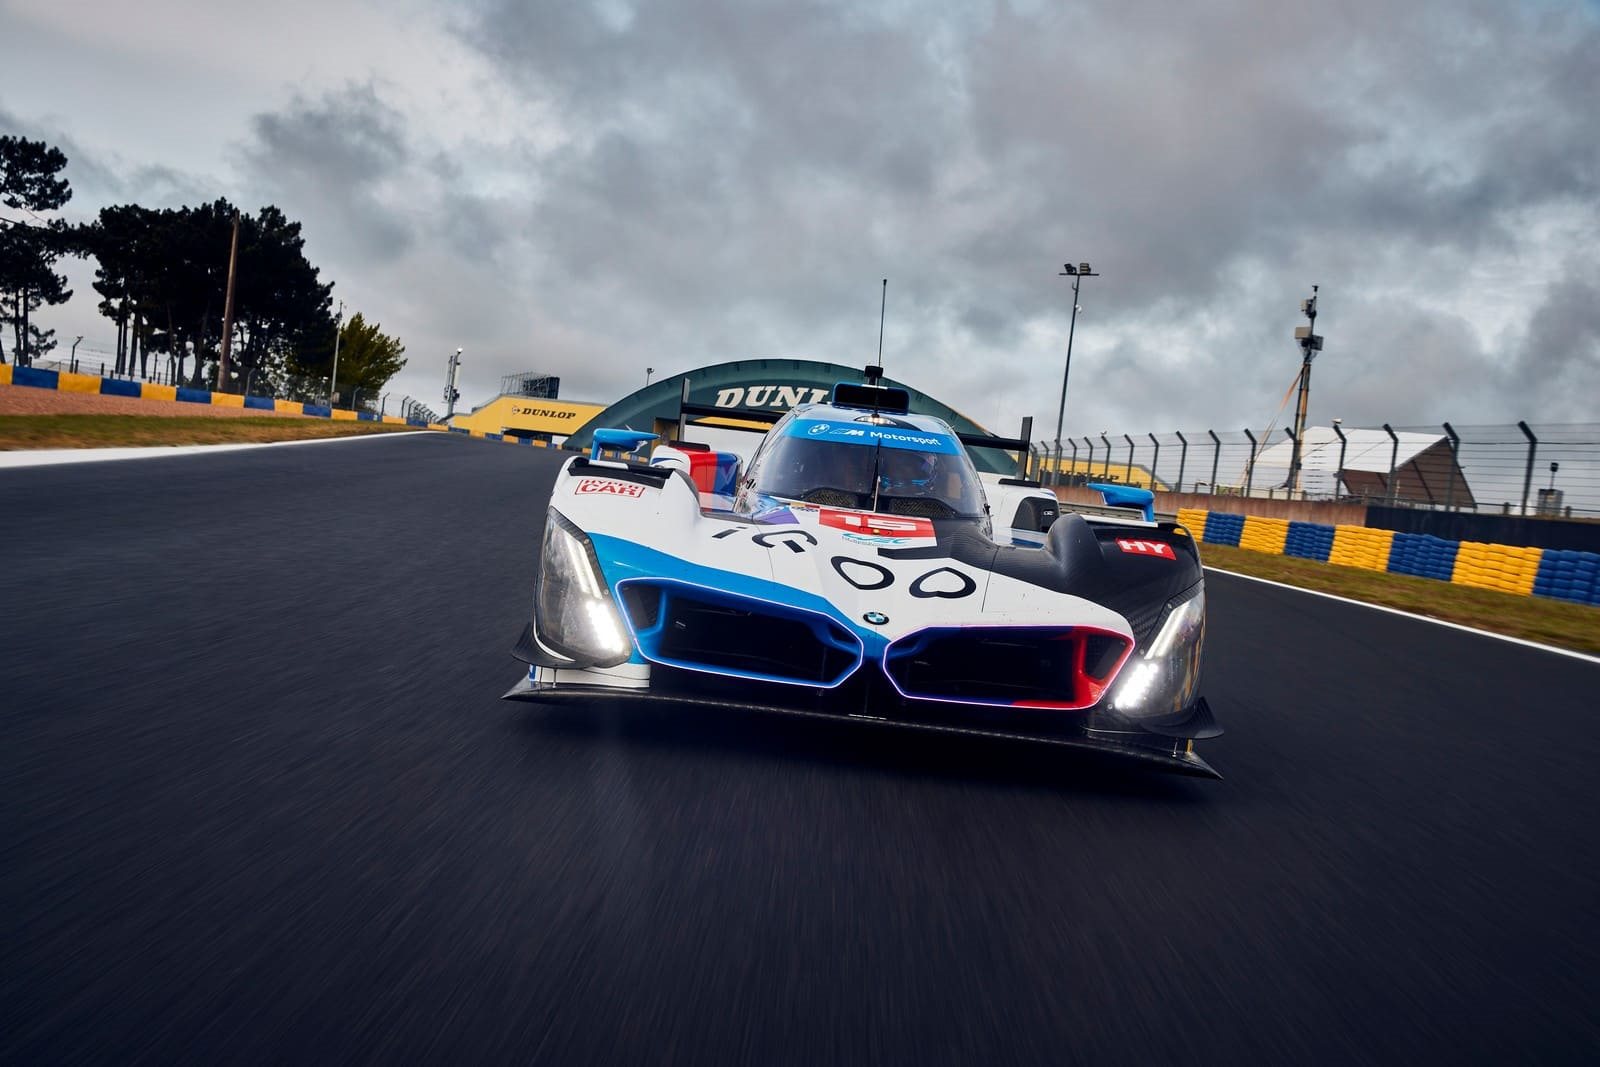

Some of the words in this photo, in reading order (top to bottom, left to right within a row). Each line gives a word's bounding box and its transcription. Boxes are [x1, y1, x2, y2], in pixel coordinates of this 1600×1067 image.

[521, 407, 576, 420] DUNLOP
[870, 431, 942, 446] Motorsport
[581, 484, 637, 495] CAR
[835, 514, 917, 531] 15
[1118, 540, 1166, 554] HY
